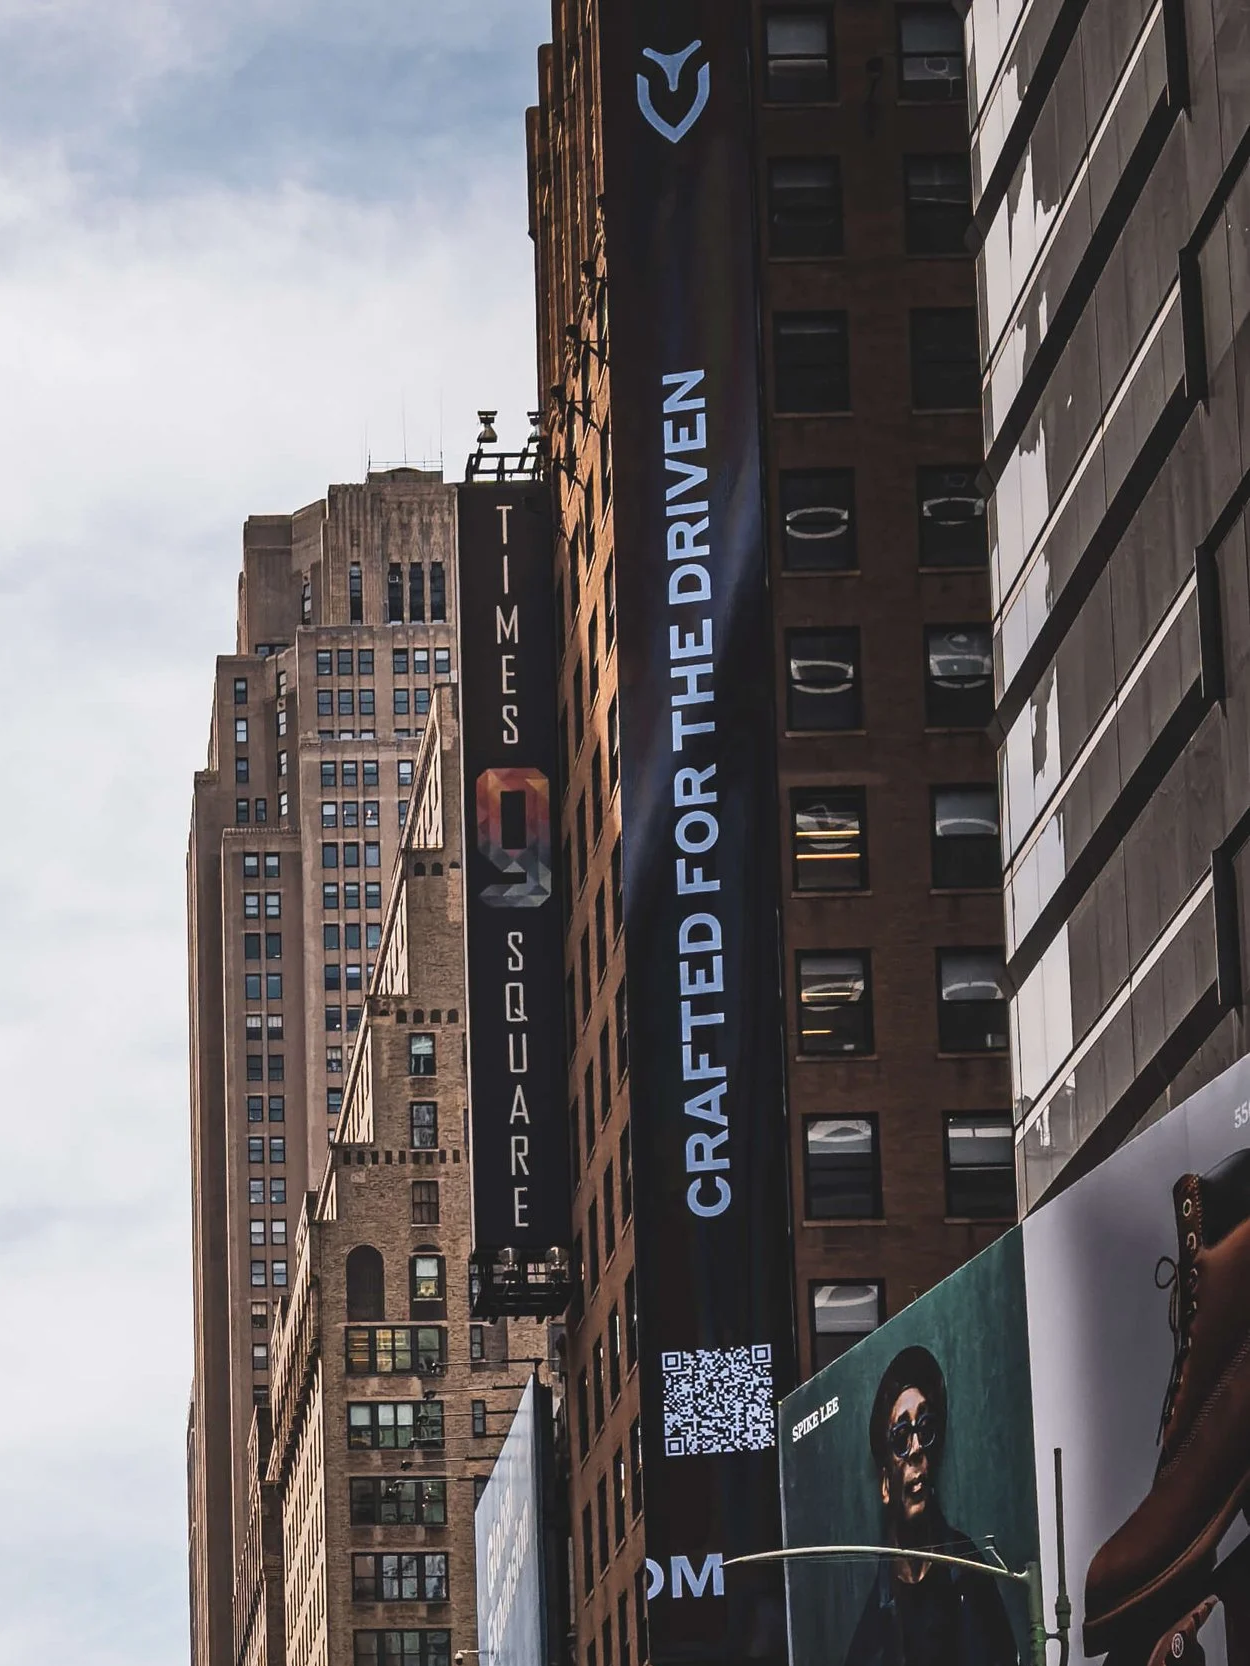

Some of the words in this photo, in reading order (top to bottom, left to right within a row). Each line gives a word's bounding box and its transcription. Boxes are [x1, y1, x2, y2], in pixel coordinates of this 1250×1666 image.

[662, 368, 713, 607] DRIVEN
[494, 504, 519, 745] TIMES
[670, 618, 716, 752] THE
[675, 761, 722, 897] FOR
[505, 931, 531, 1228] SQUARE
[681, 910, 733, 1219] CRAFTED
[792, 1408, 819, 1443] SPIKE
[819, 1396, 840, 1423] LEE
